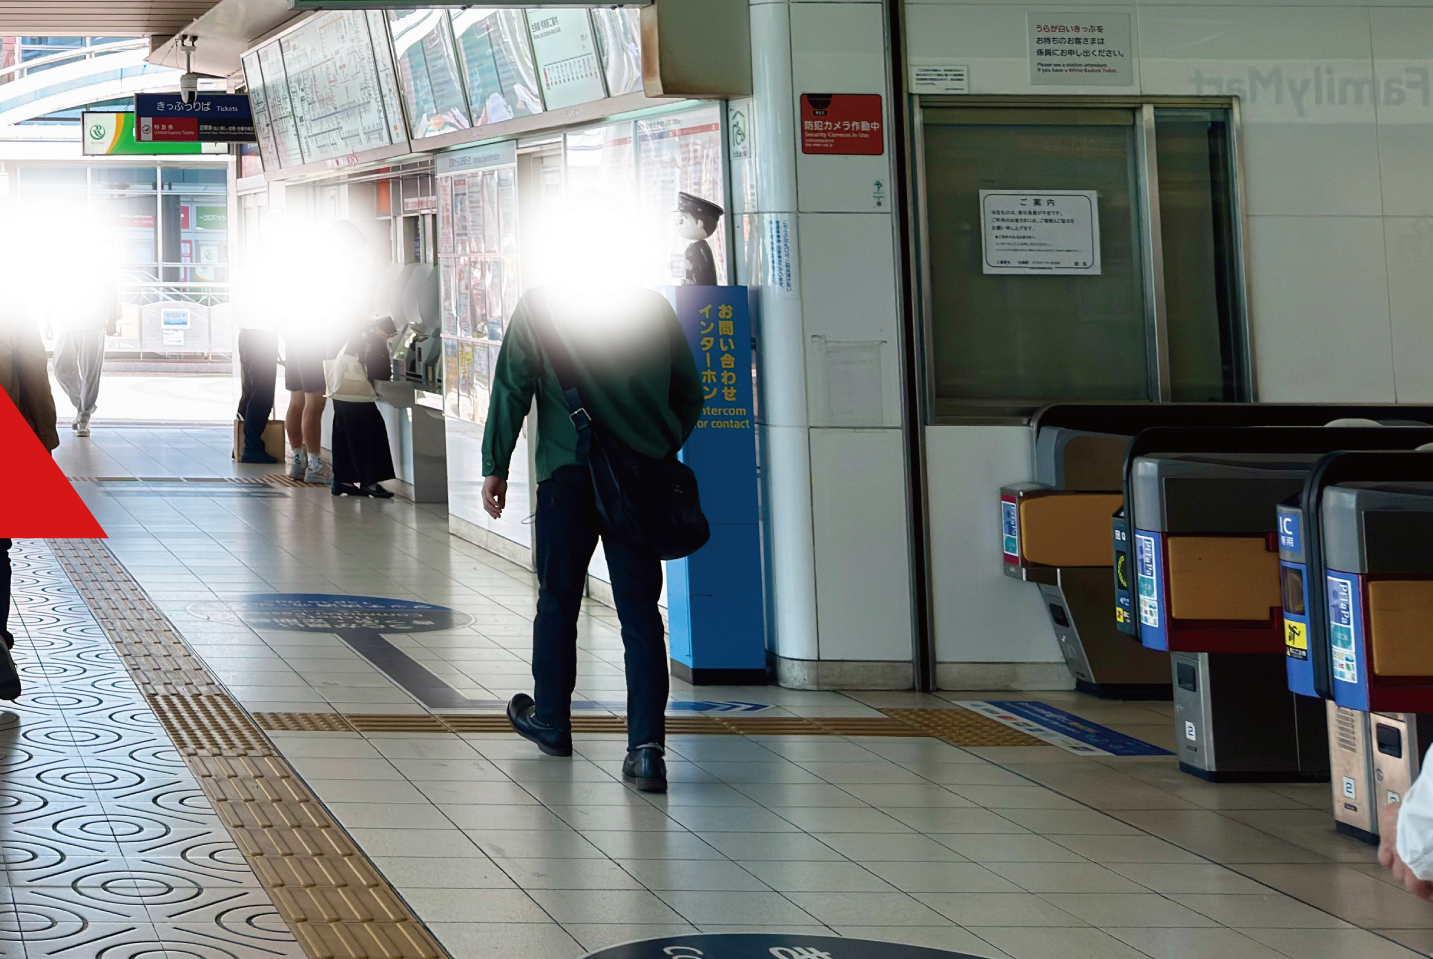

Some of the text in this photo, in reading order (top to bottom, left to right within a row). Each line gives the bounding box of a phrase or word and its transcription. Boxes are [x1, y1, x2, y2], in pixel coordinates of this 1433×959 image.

[804, 120, 880, 131] 防犯カメラ作動中
[699, 304, 719, 400] インターホン
[718, 303, 737, 402] お問い合わせ
[702, 406, 747, 416] ntercom
[711, 419, 750, 429] contact
[1279, 516, 1293, 535] IC
